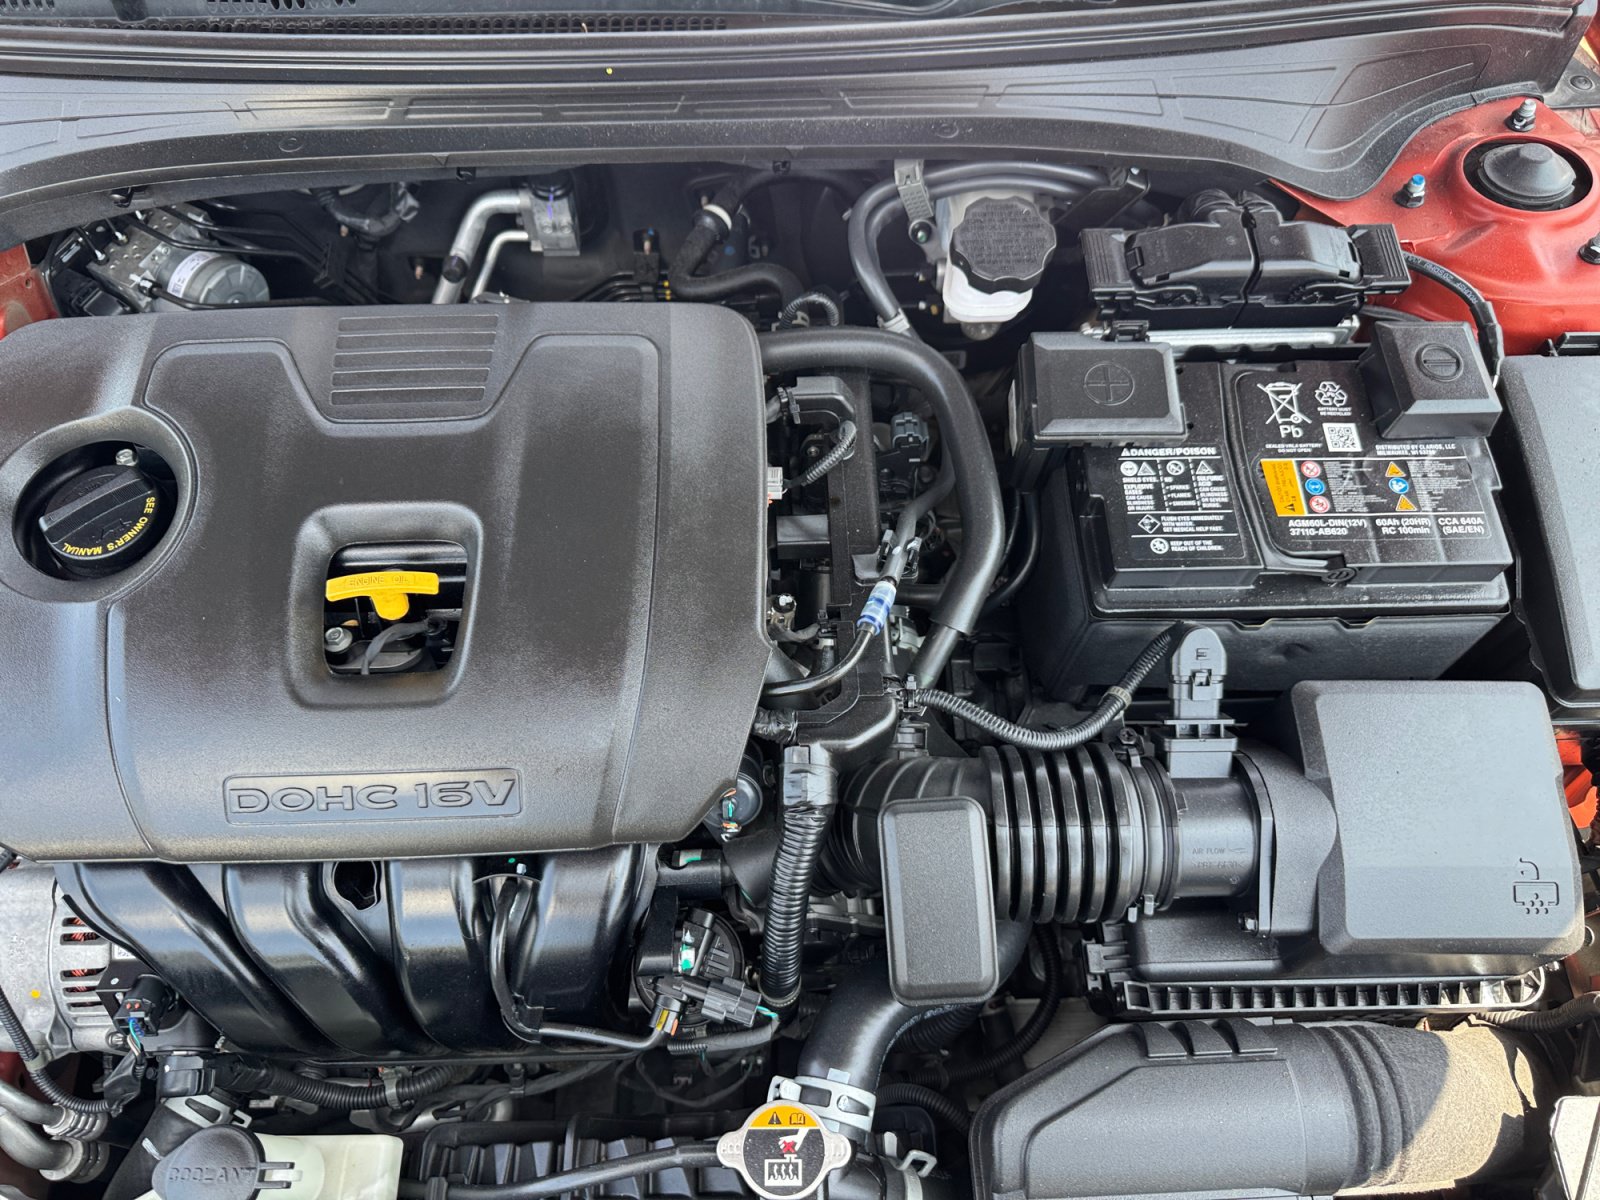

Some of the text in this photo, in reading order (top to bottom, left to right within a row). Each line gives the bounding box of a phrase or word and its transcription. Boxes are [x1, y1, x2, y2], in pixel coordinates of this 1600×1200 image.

[1279, 425, 1303, 438] Pb
[1130, 446, 1218, 457] DANGER/POISON
[62, 496, 156, 556] SEE OWNER'S MANUAL
[1288, 519, 1367, 528] AGM60L-DIN(12V)
[1375, 517, 1431, 527] 60Ah (20HR)
[1438, 517, 1484, 525] CCA 640A
[1290, 527, 1348, 536] 37110-AB620
[1382, 526, 1430, 535] RC 100min
[1442, 525, 1485, 535] (SAE/EN)
[349, 575, 409, 586] ENGINE OIL
[229, 778, 515, 813] DOHC 16V
[169, 1166, 257, 1182] COOLANT
